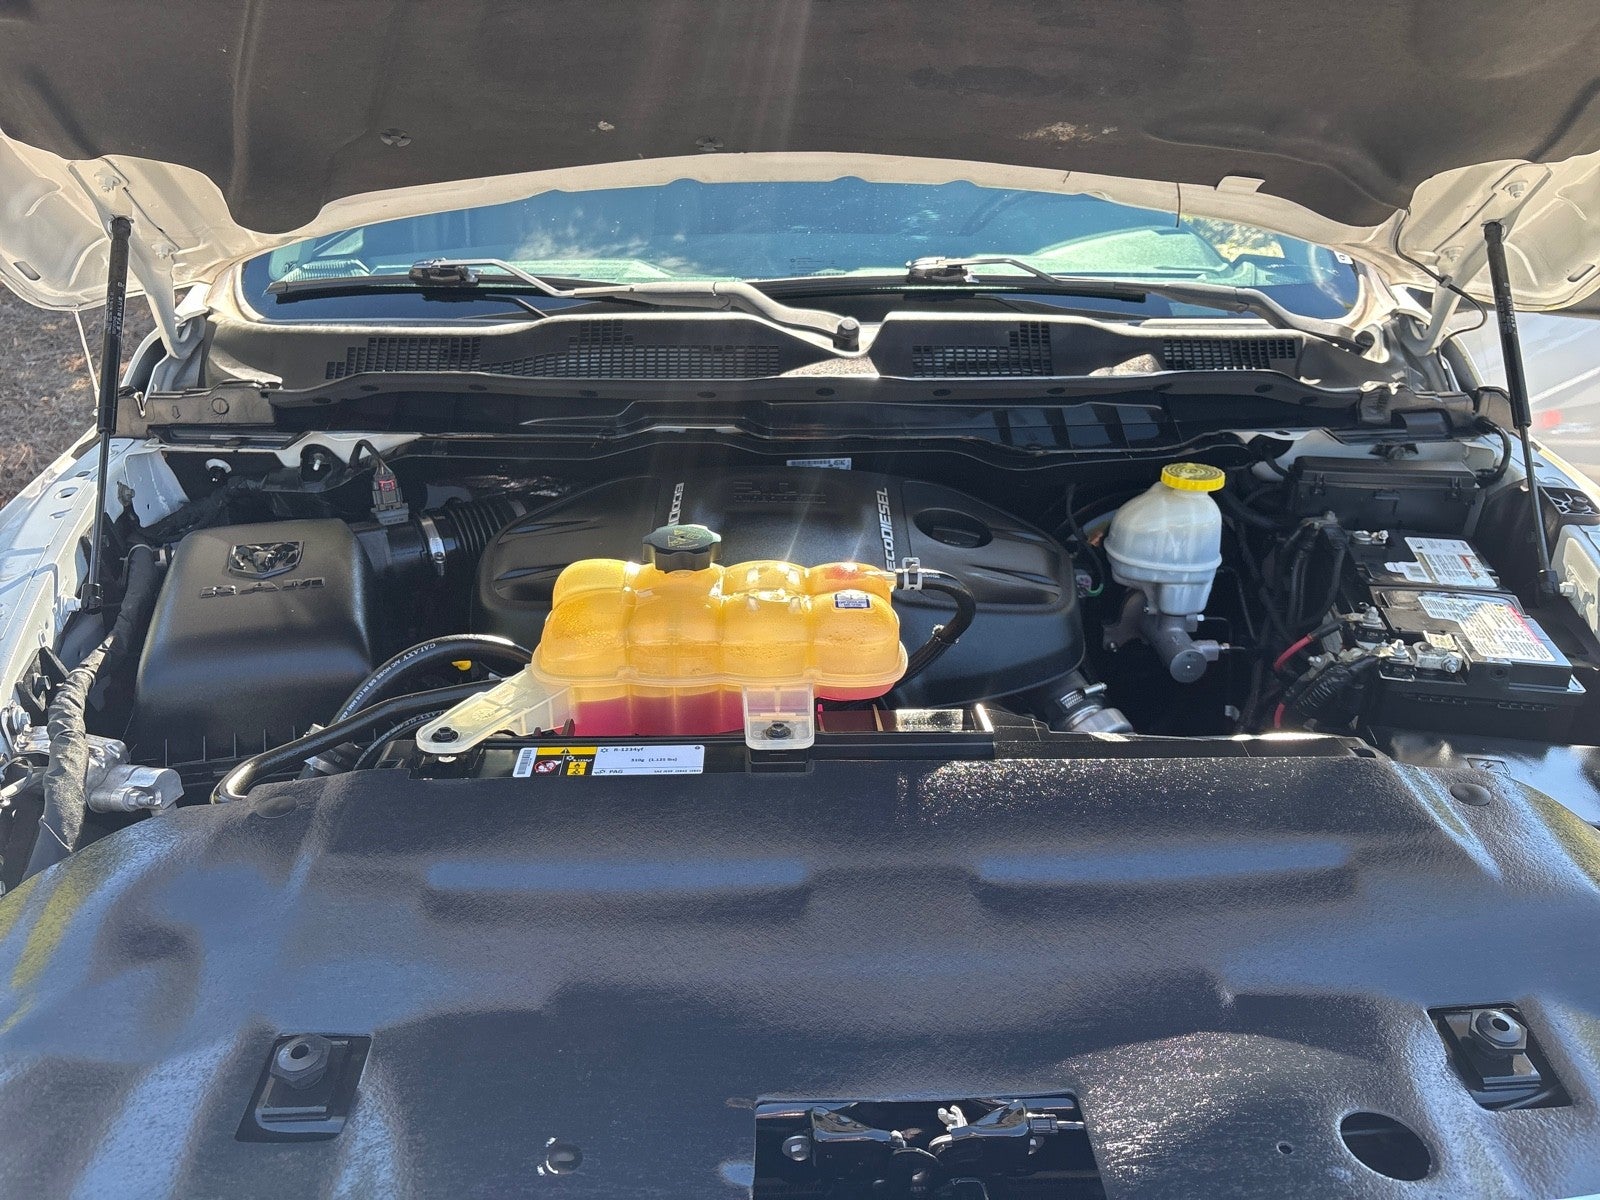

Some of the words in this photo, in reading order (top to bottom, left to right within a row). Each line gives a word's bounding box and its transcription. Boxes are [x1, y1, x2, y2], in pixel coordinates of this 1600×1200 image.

[668, 482, 685, 526] ECODI
[876, 487, 896, 572] ECODIESEL
[200, 577, 326, 599] RAM
[403, 642, 436, 662] GALAXY
[376, 666, 392, 680] HOSE
